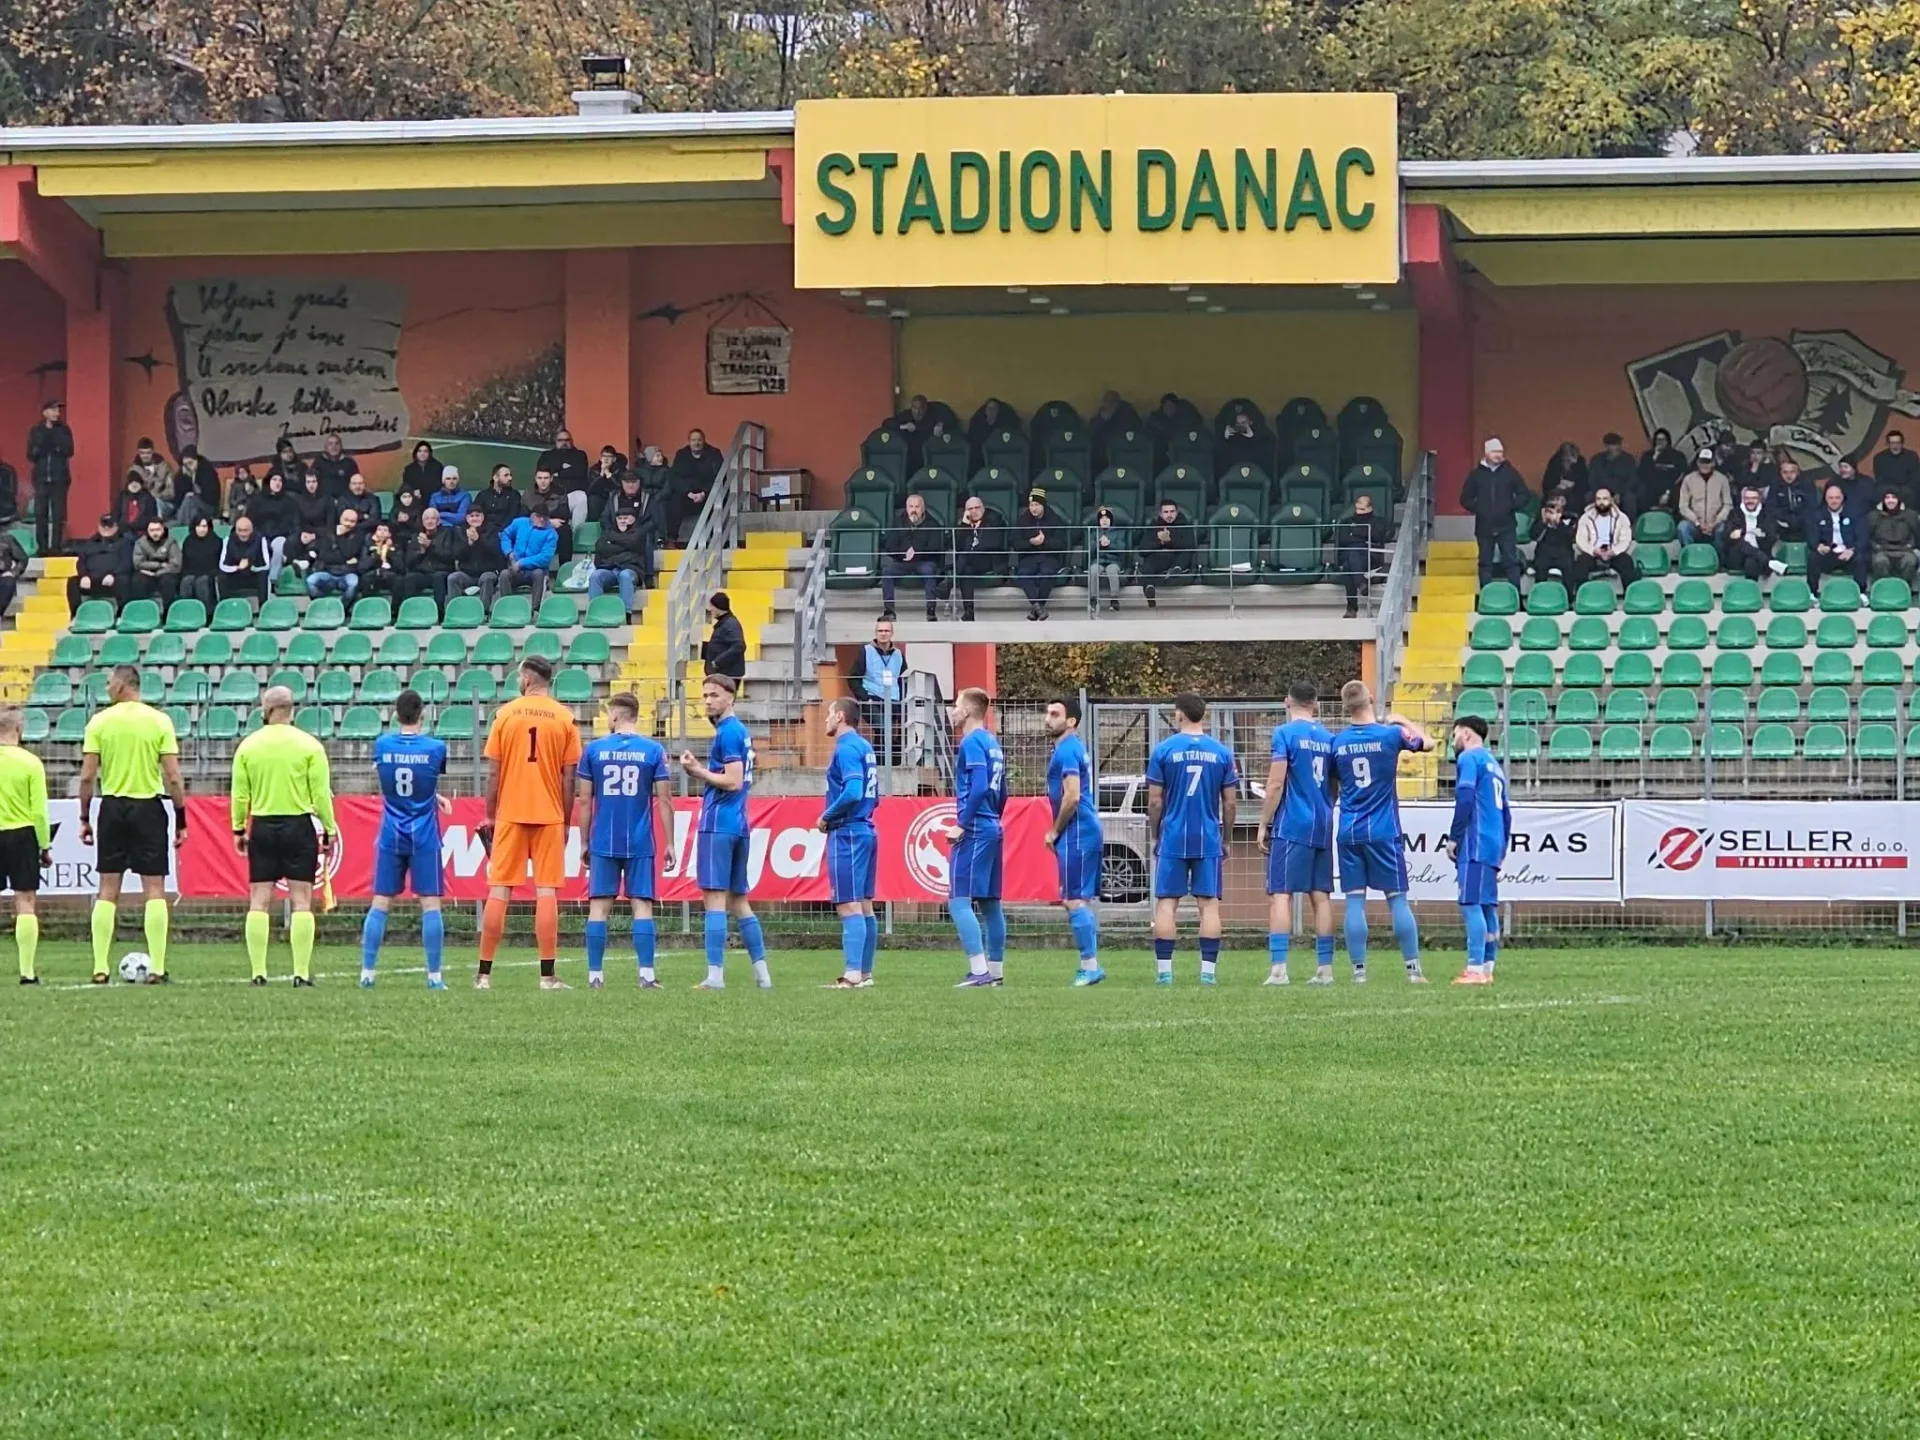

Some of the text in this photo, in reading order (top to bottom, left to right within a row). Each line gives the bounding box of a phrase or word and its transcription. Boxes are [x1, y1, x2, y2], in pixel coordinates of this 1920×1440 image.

[816, 147, 1375, 235] STADION DANAC
[273, 323, 297, 355] je
[306, 326, 345, 346] ime
[201, 386, 277, 417] Olovske
[525, 708, 556, 720] TRAVNIK
[394, 753, 430, 764] TRAVNIK
[527, 726, 538, 763] 1
[599, 751, 645, 762] NK TRAVNIK
[1172, 750, 1217, 763] NK TRAVNIK
[1348, 742, 1382, 754] TRAVNIK
[395, 767, 413, 797] 8
[603, 764, 640, 797] 28
[1186, 765, 1203, 797] 7
[1352, 757, 1372, 789] 9
[1719, 830, 1908, 852] SELLER d.o.o.
[1738, 857, 1884, 868] TRADING COMPANY
